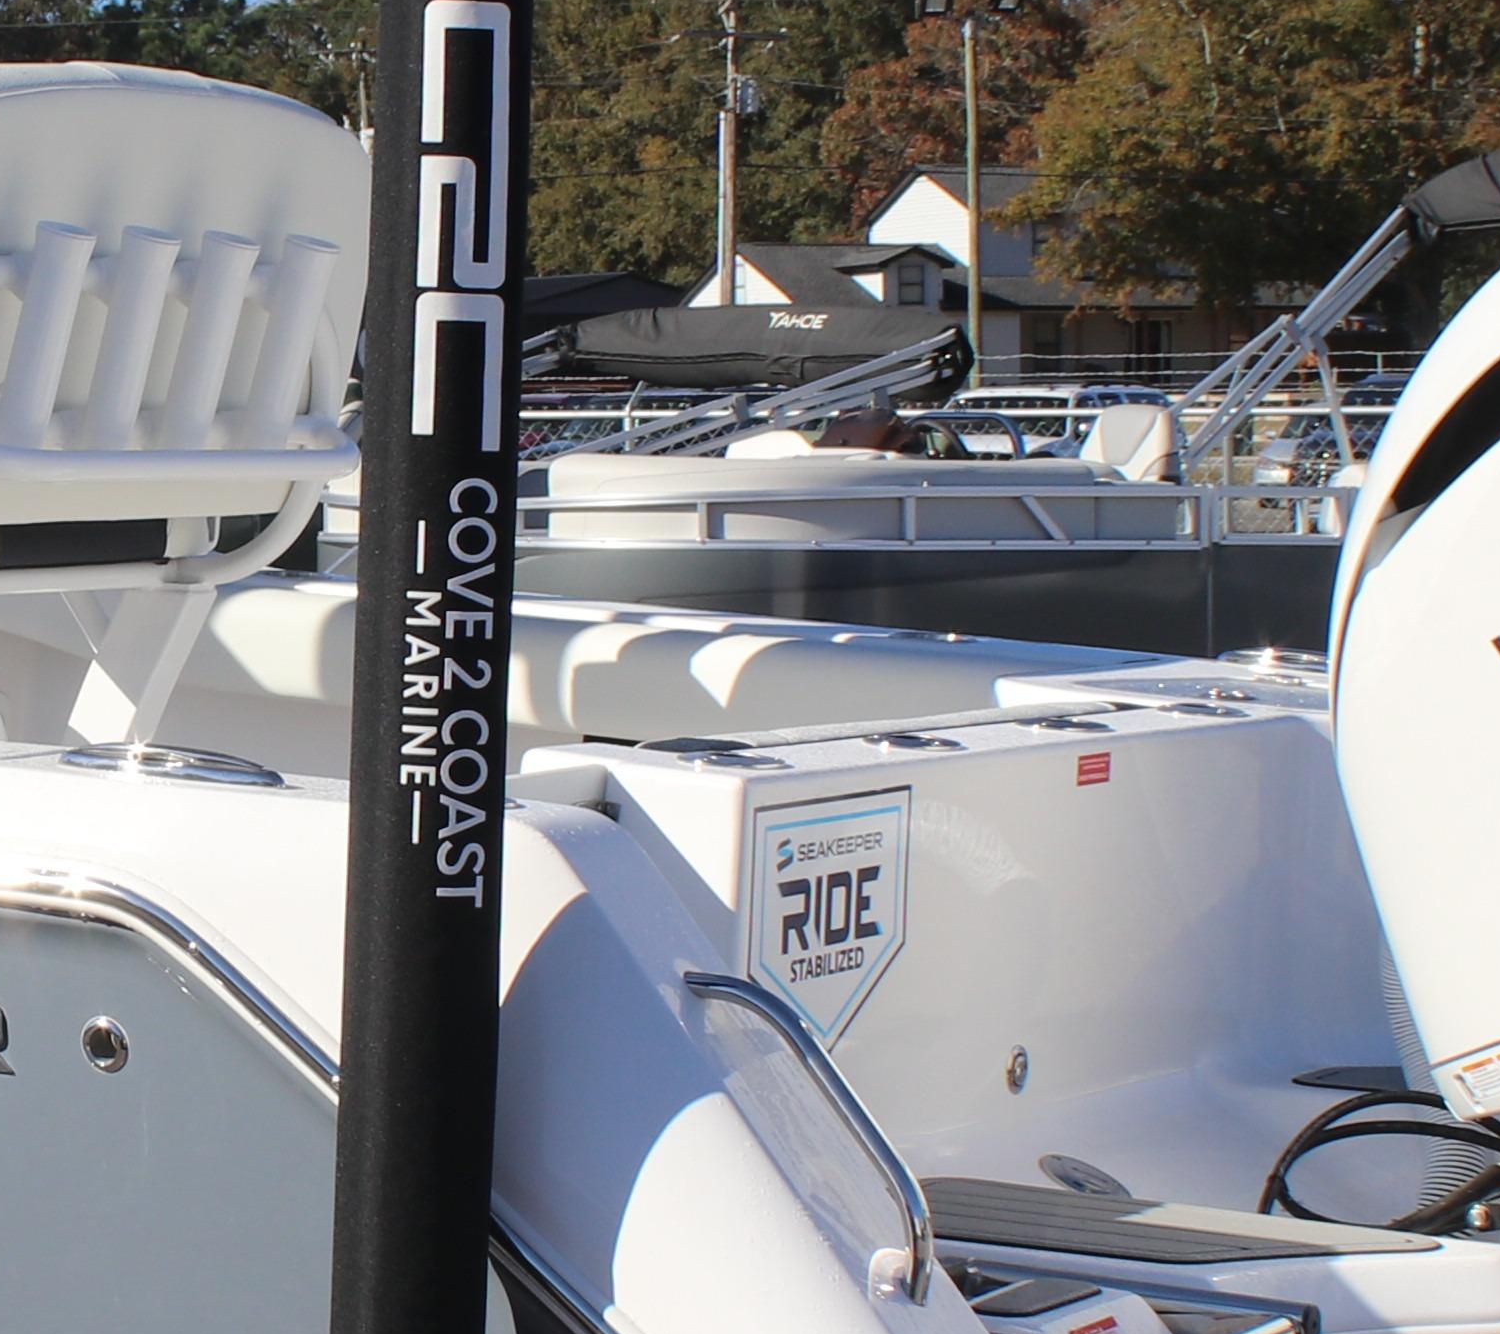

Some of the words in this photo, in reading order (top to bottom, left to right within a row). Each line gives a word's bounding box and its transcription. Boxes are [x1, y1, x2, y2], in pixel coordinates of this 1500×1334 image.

[768, 311, 829, 329] TAHOE
[444, 478, 499, 640] COVE
[400, 589, 442, 787] MARINE
[443, 656, 492, 691] 2
[436, 709, 490, 908] COAST
[797, 831, 883, 862] SEAKEEPER
[777, 864, 883, 955] RIDE
[789, 946, 865, 983] STABILIZED
